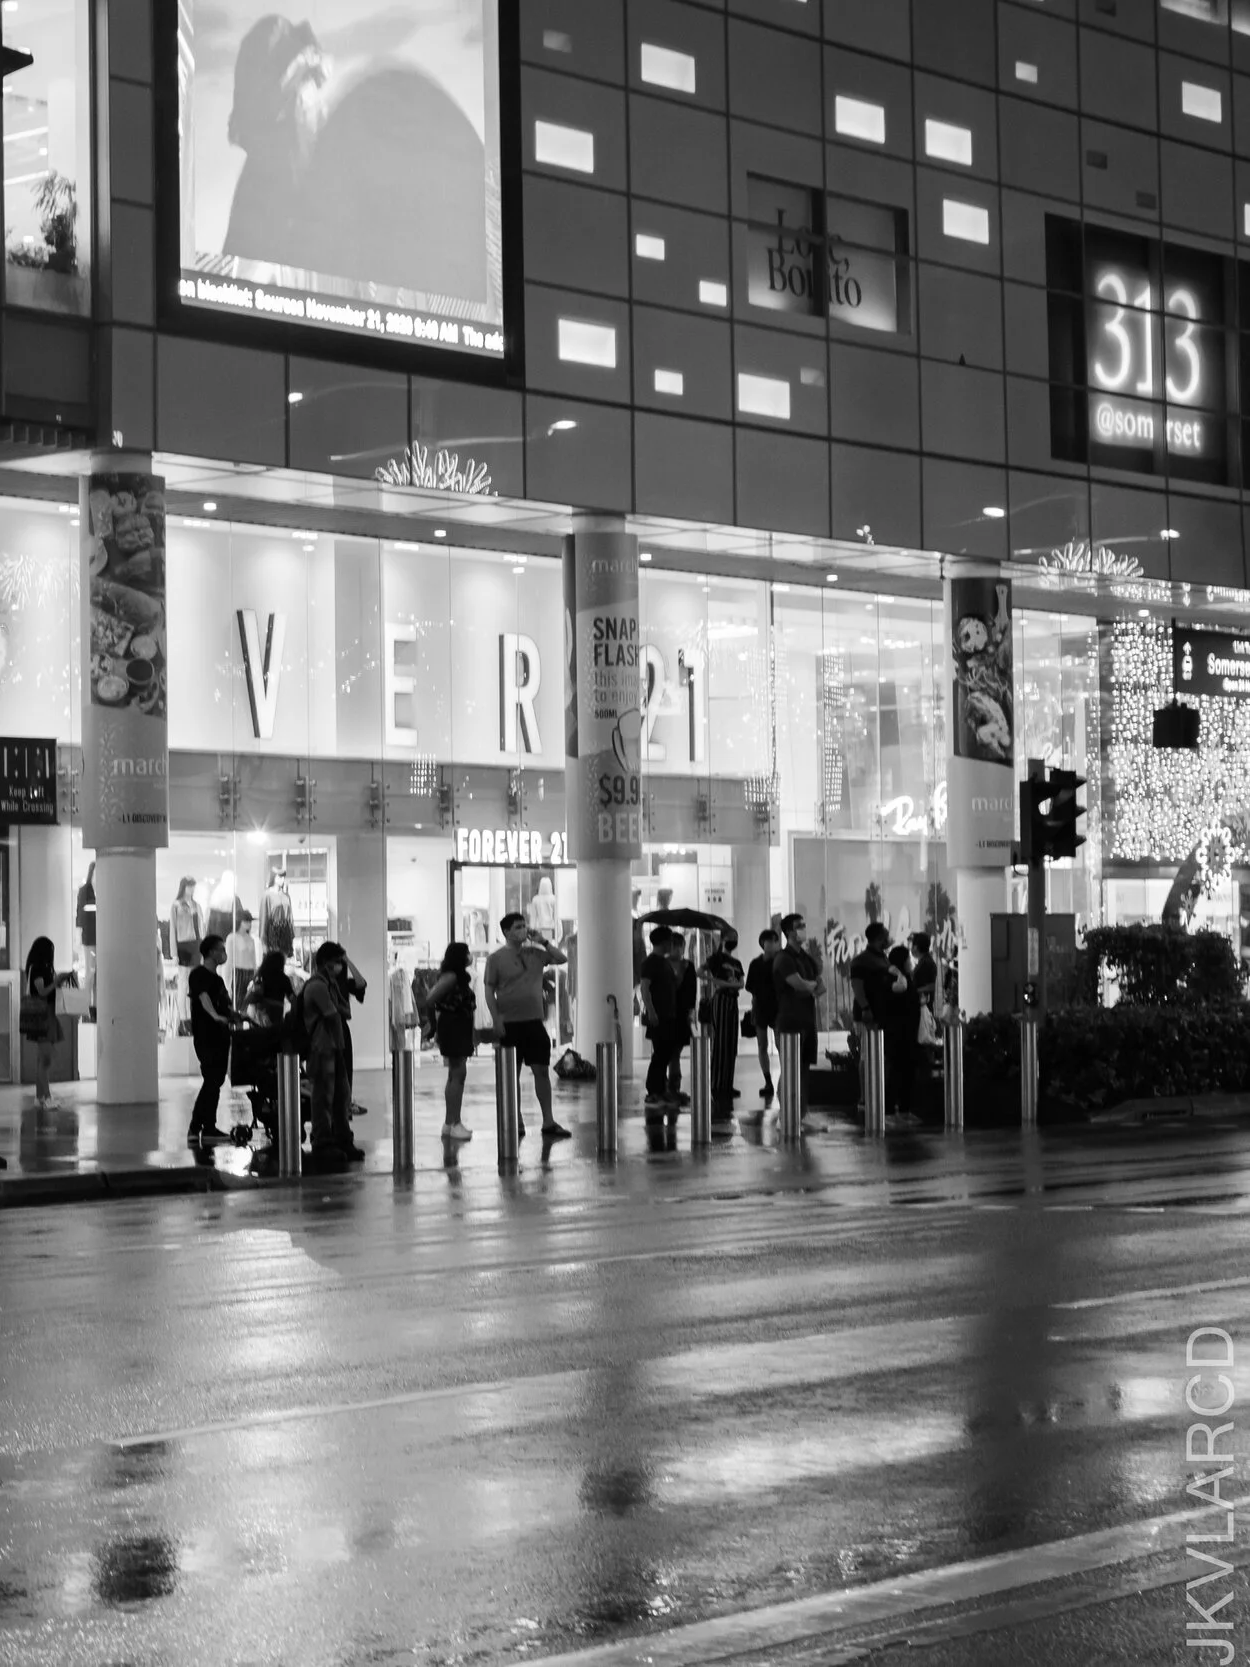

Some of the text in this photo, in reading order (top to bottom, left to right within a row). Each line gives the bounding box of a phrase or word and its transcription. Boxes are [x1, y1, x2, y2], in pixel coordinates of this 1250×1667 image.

[777, 209, 850, 273] Loe,
[1095, 272, 1200, 401] 313
[1097, 403, 1201, 447] @somrset
[594, 671, 617, 687] this
[1207, 652, 1250, 677] Somerse
[594, 689, 607, 703] to
[30, 785, 44, 799] Lft
[599, 773, 640, 808] $9.9
[0, 800, 54, 816] While Crossing
[599, 812, 640, 843] BEE
[457, 827, 569, 864] FOREVER 21
